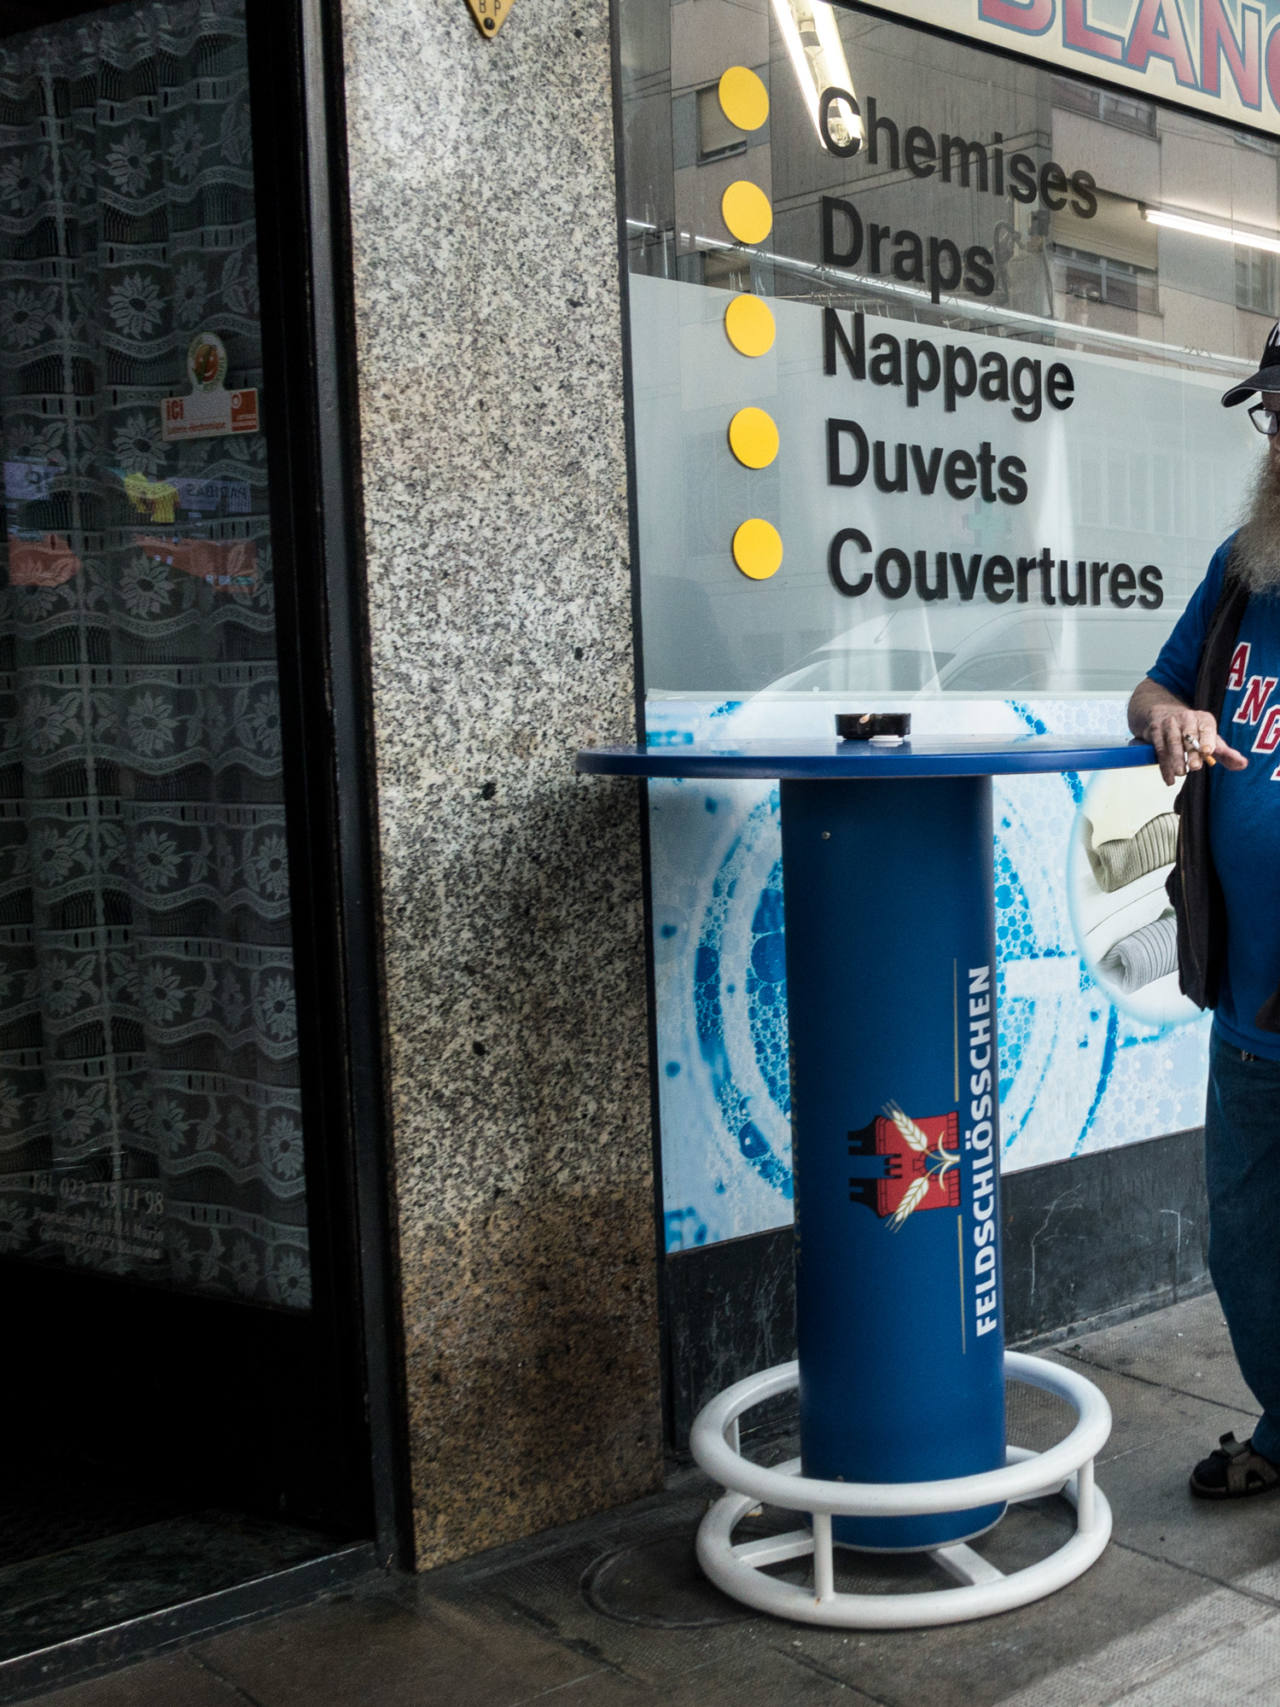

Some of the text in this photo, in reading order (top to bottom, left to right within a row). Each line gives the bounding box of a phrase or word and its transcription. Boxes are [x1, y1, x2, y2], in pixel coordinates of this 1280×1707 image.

[819, 86, 1098, 219] Chemises
[820, 195, 995, 304] Draps
[822, 306, 1075, 422] Nappage
[826, 417, 1029, 505] Duvets
[828, 527, 1164, 610] Couvertures
[966, 965, 998, 1337] FELDSCHLÖSSCHEN
